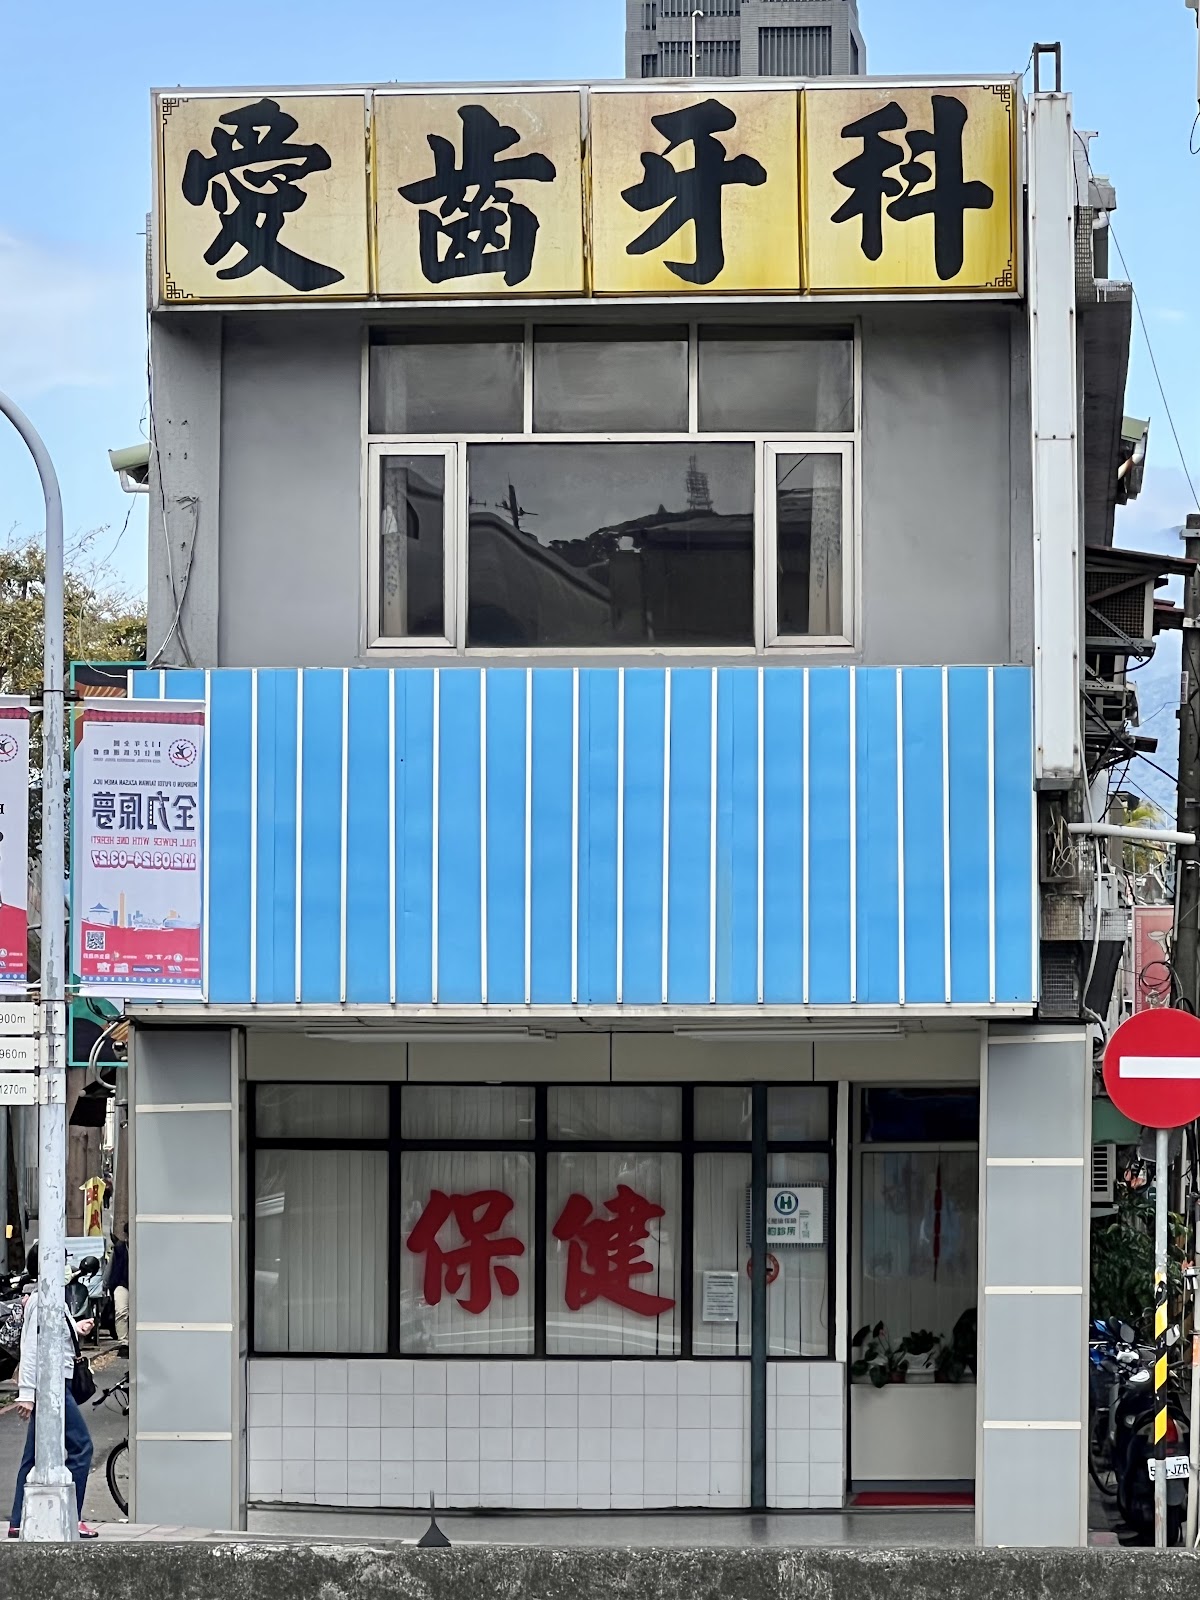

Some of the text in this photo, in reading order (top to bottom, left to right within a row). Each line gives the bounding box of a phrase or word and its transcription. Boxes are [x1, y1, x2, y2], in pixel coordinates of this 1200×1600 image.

[182, 95, 994, 296] 愛齒牙科
[406, 1184, 676, 1317] 保健
